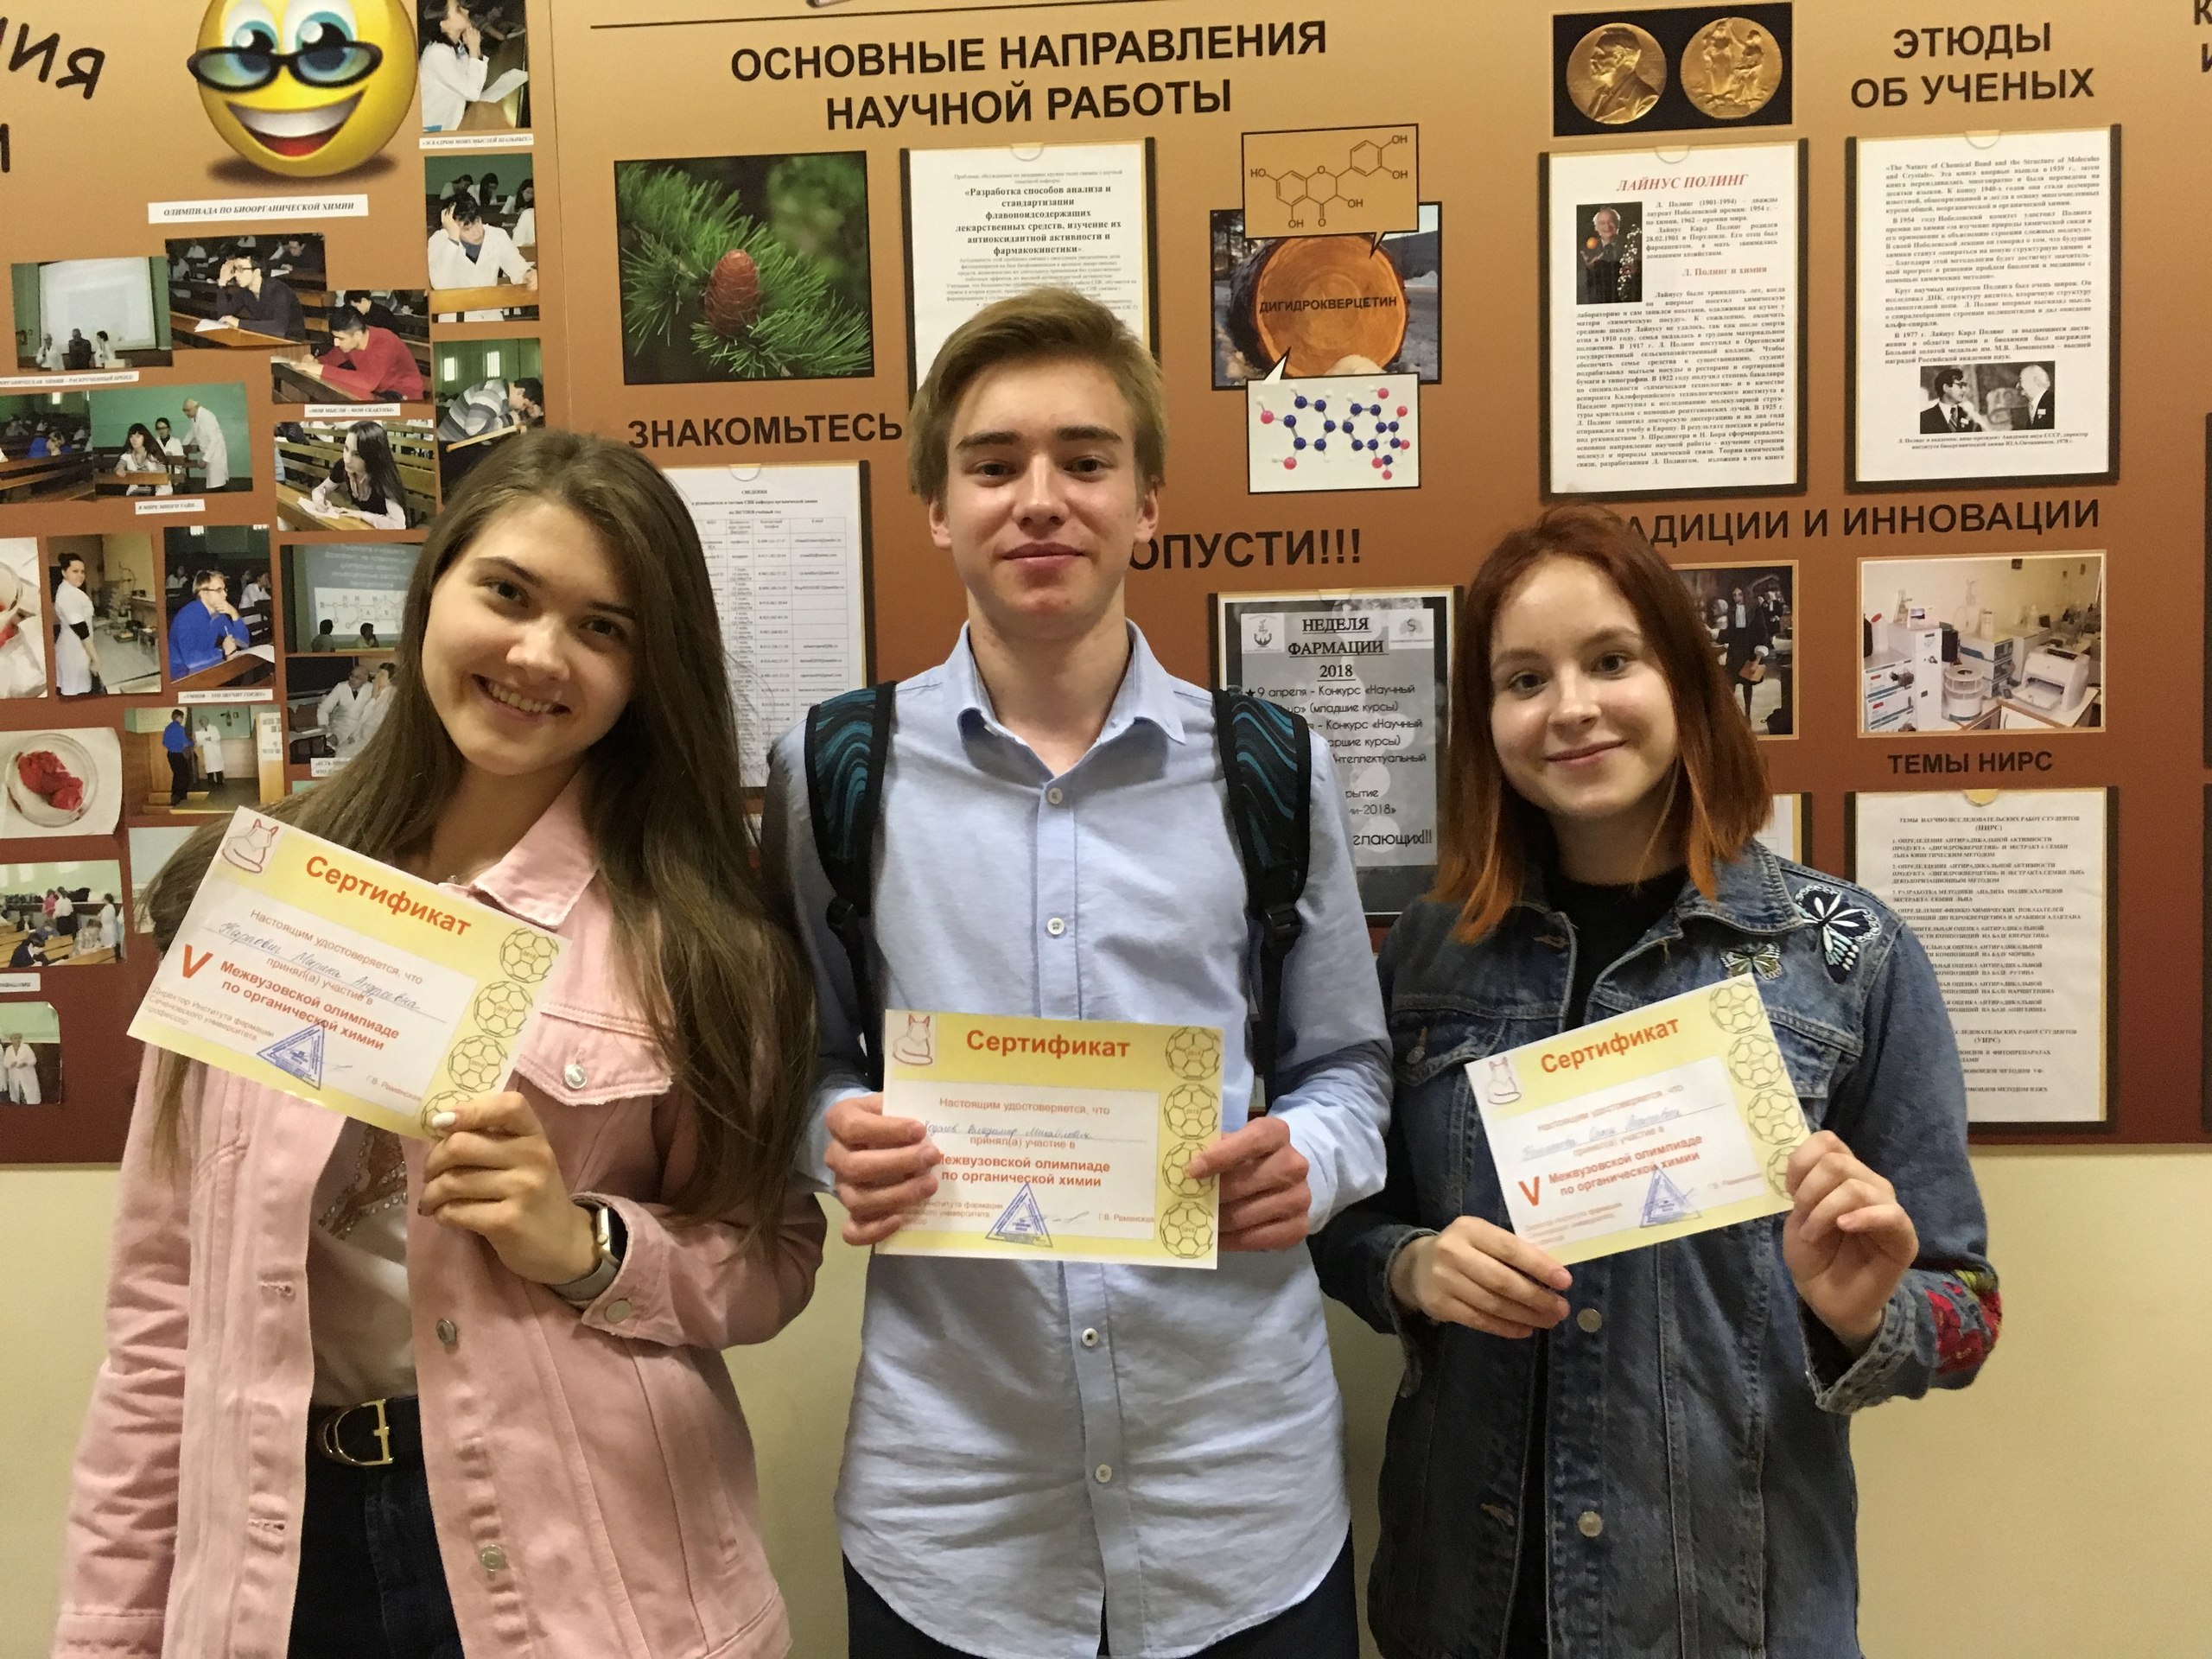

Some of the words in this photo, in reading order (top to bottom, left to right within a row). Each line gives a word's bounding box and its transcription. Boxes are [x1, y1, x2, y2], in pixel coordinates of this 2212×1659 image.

[1893, 22, 2050, 60] ЭТЮДЫ
[0, 16, 105, 100] ИЯ
[732, 38, 985, 81] ОСНОВНЫЕ
[1001, 20, 1325, 70] НАПРАВЛЕНИЯ
[1851, 77, 1908, 108] ОБ
[1922, 67, 2094, 105] УЧЕНЫХ
[827, 80, 1031, 130] НАУЧНОЙ
[1048, 79, 1230, 120] РАБОТЫ
[1391, 135, 1408, 143] OH
[1250, 168, 1267, 178] HO
[1392, 170, 1408, 179] OH
[1617, 176, 1681, 191] ЛАЙНУС
[1683, 174, 1749, 188] ПОЛИНГ
[964, 188, 1021, 197] «Разработка
[1023, 187, 1064, 195] способов
[163, 207, 218, 216] ОЛИМПИАДА
[233, 203, 321, 213] БИООРГАНИЧЕСКОЙ
[1001, 199, 1074, 208] стандартизации
[1347, 199, 1363, 208] OH
[985, 210, 1091, 221] флавоноидсодержащих
[1287, 219, 1304, 228] OH
[955, 223, 1026, 232] лекарственных
[1027, 222, 1065, 232] средств,
[1067, 221, 1109, 231] изучение
[967, 234, 1047, 244] антиоксидантной
[1049, 233, 1103, 242] активности
[1694, 267, 1728, 276] Полинг
[1260, 296, 1397, 314] ДИГИДРОКВЕРЦЕТИН
[628, 413, 902, 448] ЗНАКОМЬТЕСЬ
[1804, 508, 1828, 537] И
[1843, 499, 2100, 537] ИННОВАЦИИ
[1301, 618, 1370, 632] НЕДЕЛЯ
[1287, 640, 1384, 655] ФАРМАЦИИ
[1319, 664, 1354, 678] 2018
[1257, 687, 1265, 697] 9
[1268, 688, 1307, 698] апреля
[1318, 685, 1361, 696] Конкурс
[1365, 684, 1416, 695] «Научный
[1310, 702, 1359, 714] (младшие
[1363, 700, 1399, 714] курсы)
[1325, 719, 1369, 731] Конкурс
[1372, 718, 1423, 729] «Научный
[1364, 734, 1402, 747] курсы)
[1887, 753, 1969, 774] ТЕМЫ
[1979, 751, 2053, 772] НИРС
[307, 855, 472, 936] Сертификат
[250, 909, 314, 942] Настоящим
[316, 936, 401, 978] удостоверяется,
[404, 972, 423, 985] что
[182, 944, 213, 979] V
[266, 958, 320, 987] принял(а)
[321, 979, 364, 1003] участие
[365, 997, 374, 1006] в
[219, 960, 321, 1007] Межвузовской
[324, 1003, 401, 1039] олимпиаде
[192, 1001, 232, 1021] Института
[221, 981, 241, 994] по
[244, 988, 338, 1033] органической
[339, 1027, 385, 1052] химии
[967, 1029, 1130, 1058] Сертификат
[1541, 1019, 1679, 1073] Сертификат
[939, 1097, 1001, 1112] Настоящим
[1003, 1101, 1090, 1116] удостоверяется,
[1092, 1106, 1110, 1116] что
[969, 1136, 1022, 1149] принял(а)
[1024, 1140, 1067, 1150] участие
[1036, 1160, 1110, 1173] олимпиаде
[1548, 1154, 1632, 1185] Межвузовской
[1635, 1135, 1703, 1161] олимпиаде
[942, 1172, 958, 1181] по
[962, 1173, 1054, 1185] органической
[1058, 1176, 1102, 1187] химии
[1560, 1185, 1583, 1196] по
[1578, 1163, 1658, 1194] органической
[1661, 1152, 1700, 1169] химии
[1518, 1176, 1541, 1206] V
